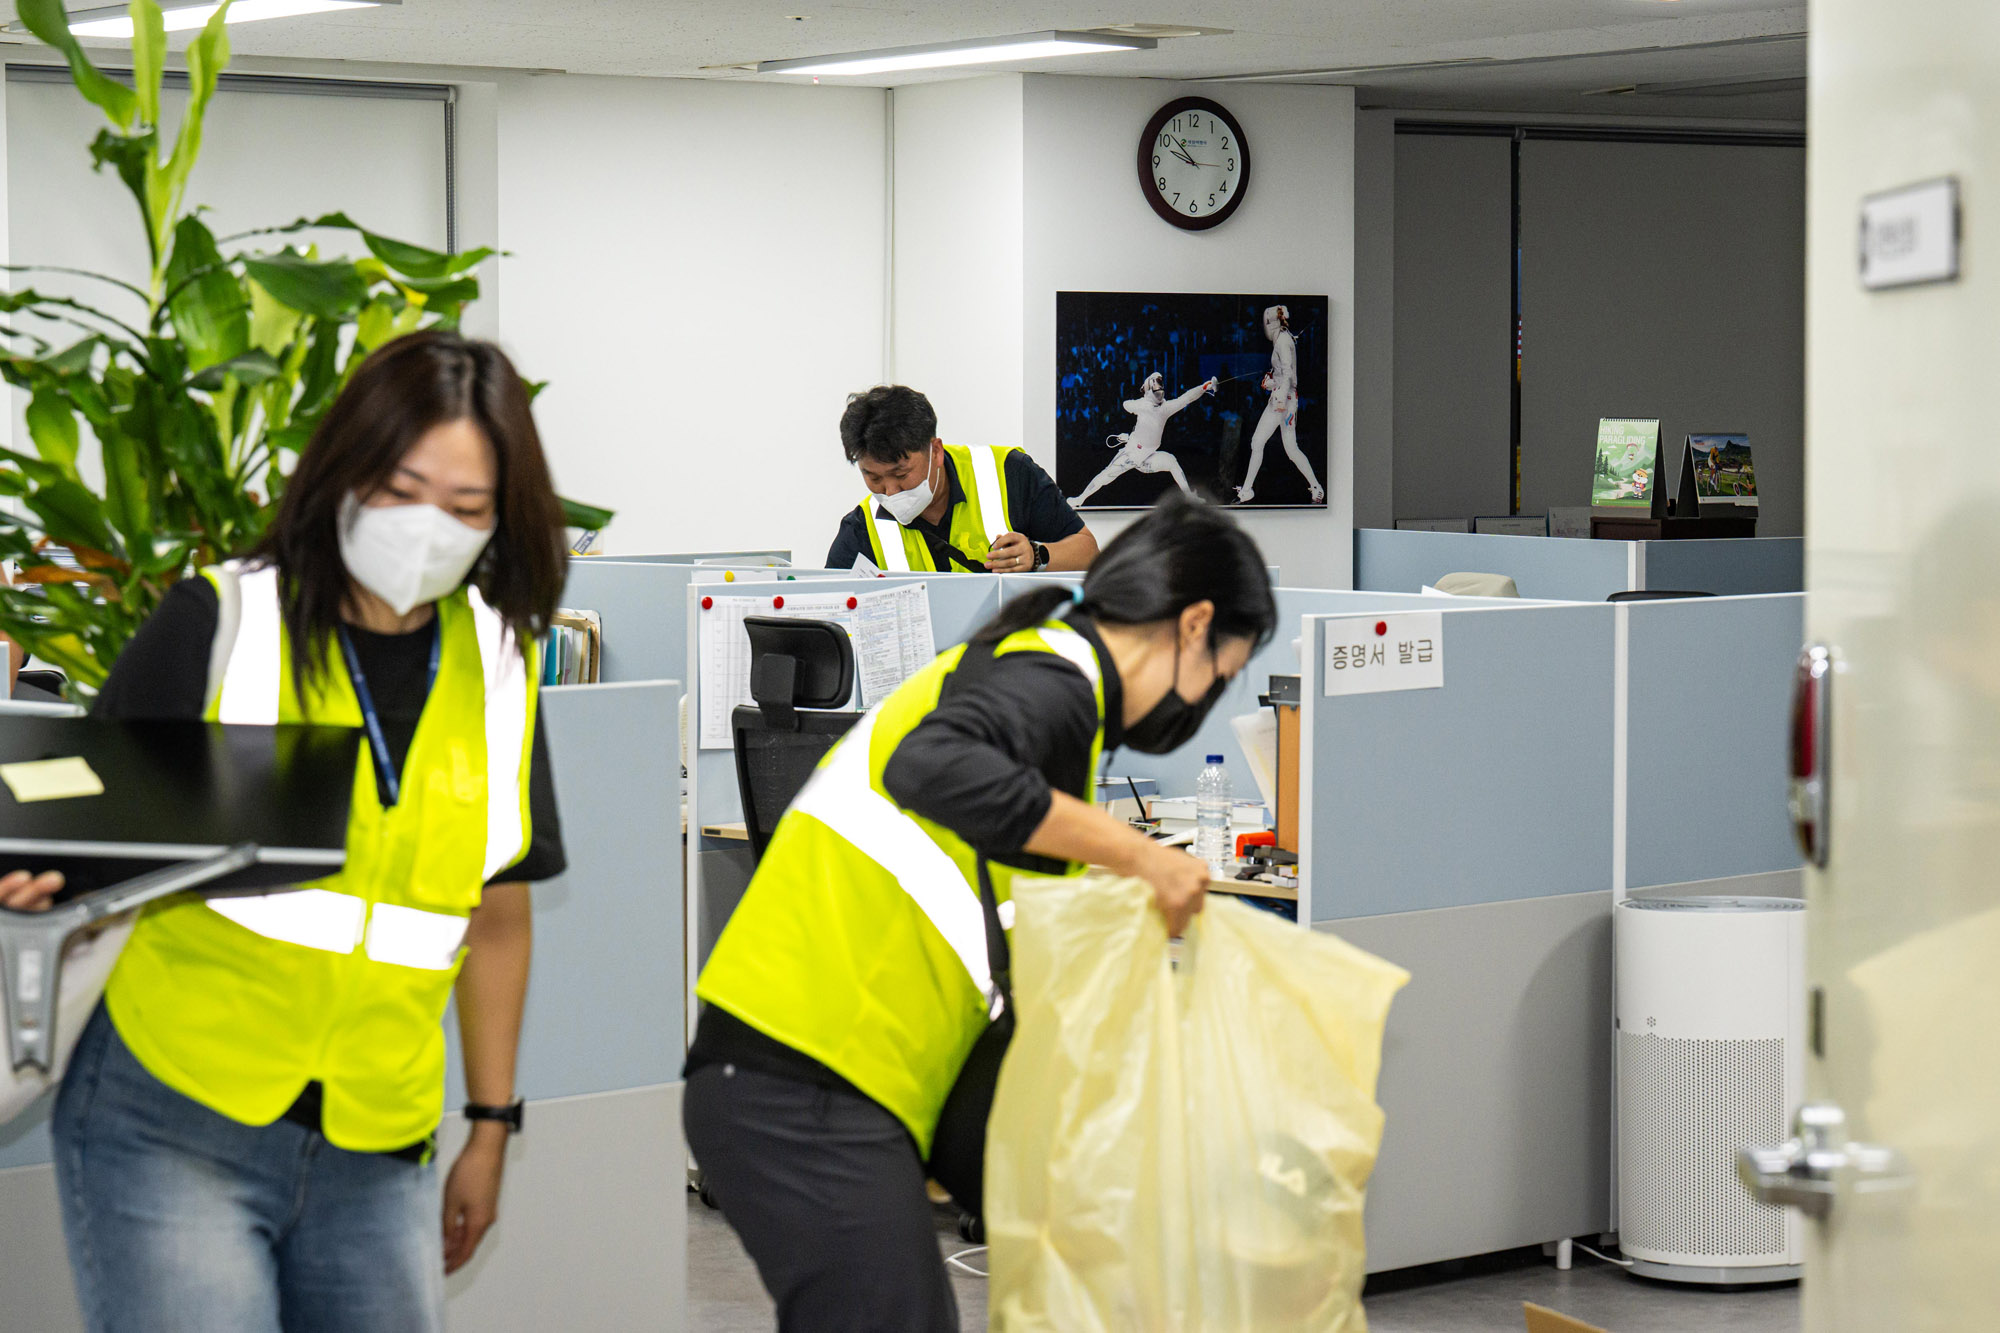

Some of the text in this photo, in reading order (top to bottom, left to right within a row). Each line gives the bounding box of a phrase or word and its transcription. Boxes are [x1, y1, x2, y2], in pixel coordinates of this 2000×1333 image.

[1172, 119, 1181, 133] 11
[1189, 114, 1199, 128] 12
[1210, 120, 1214, 134] 1
[1159, 133, 1171, 148] 10
[1221, 136, 1228, 149] 2
[1152, 155, 1161, 169] 9
[1227, 158, 1234, 171] 3
[1158, 177, 1166, 191] 8
[1219, 180, 1227, 194] 4
[1172, 192, 1181, 206] 7
[1189, 199, 1198, 213] 6
[1208, 193, 1215, 207] 5
[1600, 426, 1624, 435] HIKING
[1599, 436, 1645, 445] PARAGLIDING
[1333, 639, 1433, 670] 증명서 발급
